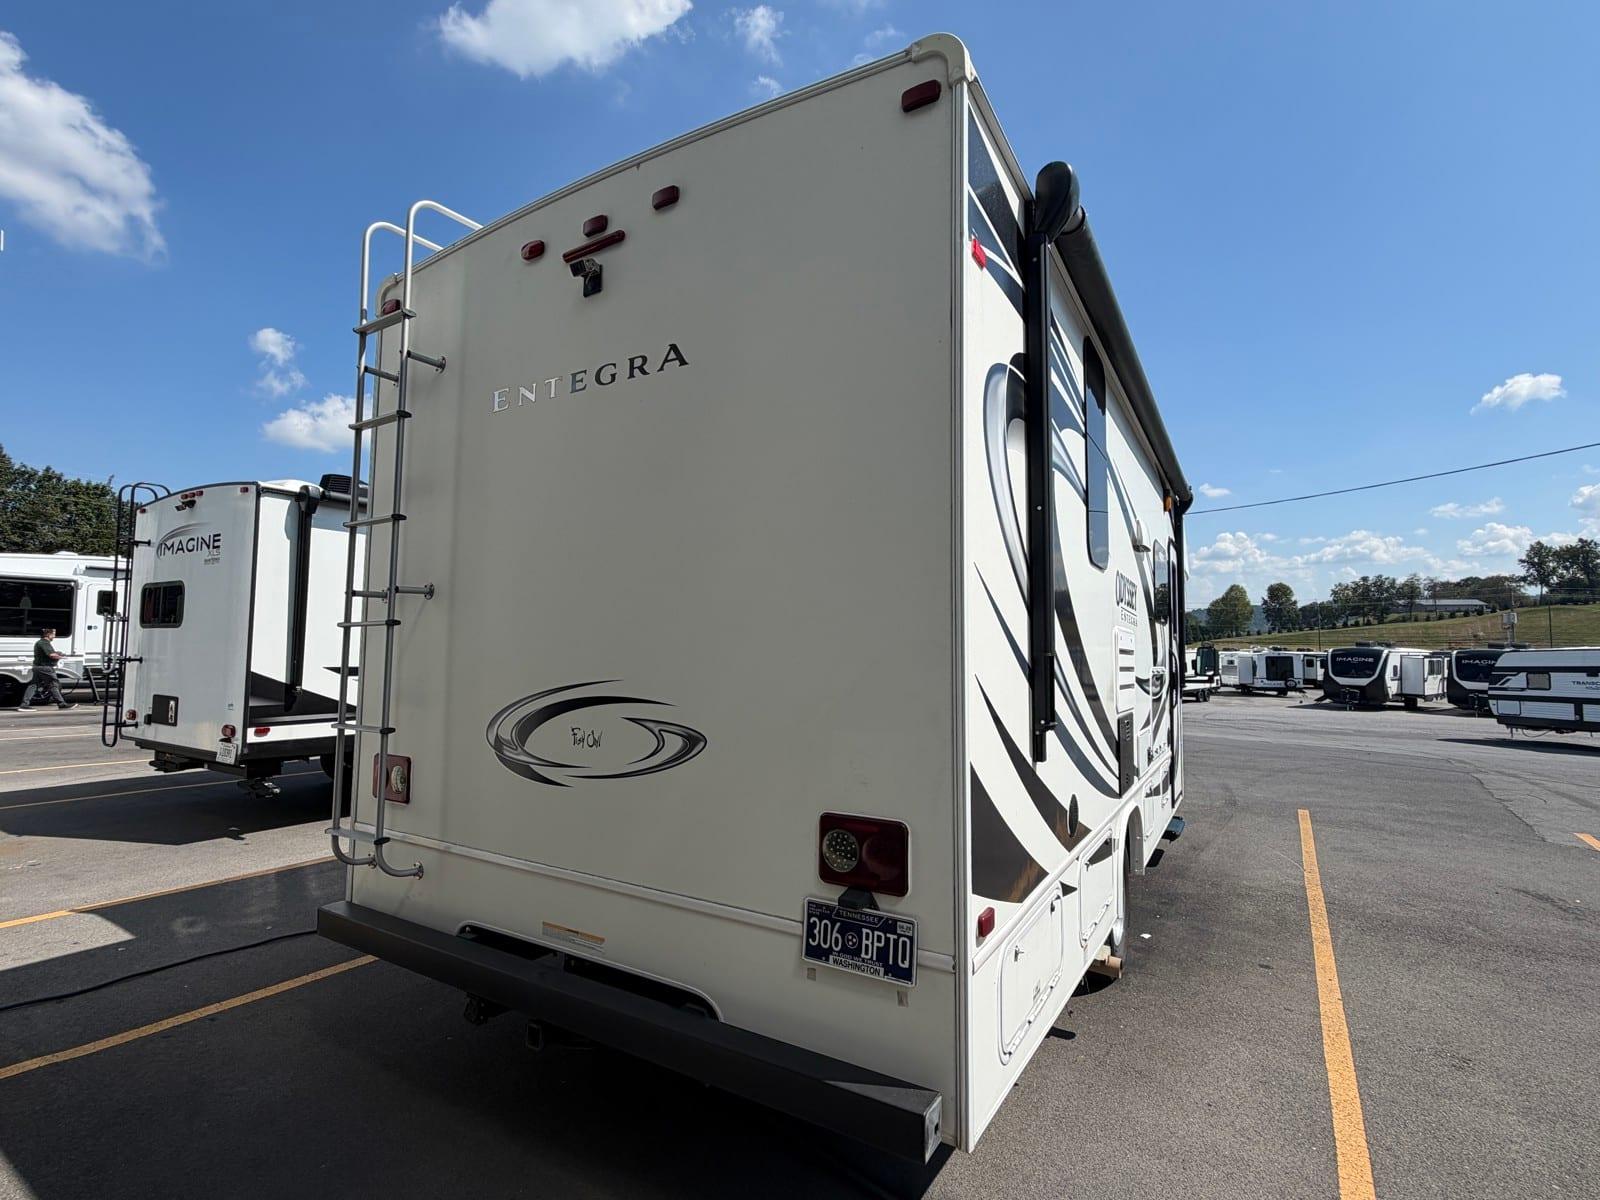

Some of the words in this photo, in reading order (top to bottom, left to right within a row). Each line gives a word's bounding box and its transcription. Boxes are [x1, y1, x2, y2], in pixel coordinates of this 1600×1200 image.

[491, 343, 689, 413] ENTEGRA
[159, 533, 221, 557] IMAGINE
[839, 910, 880, 923] TENNESSEE
[808, 917, 842, 951] 306
[860, 928, 911, 968] BPTQ
[832, 956, 881, 977] WASHINGTON
